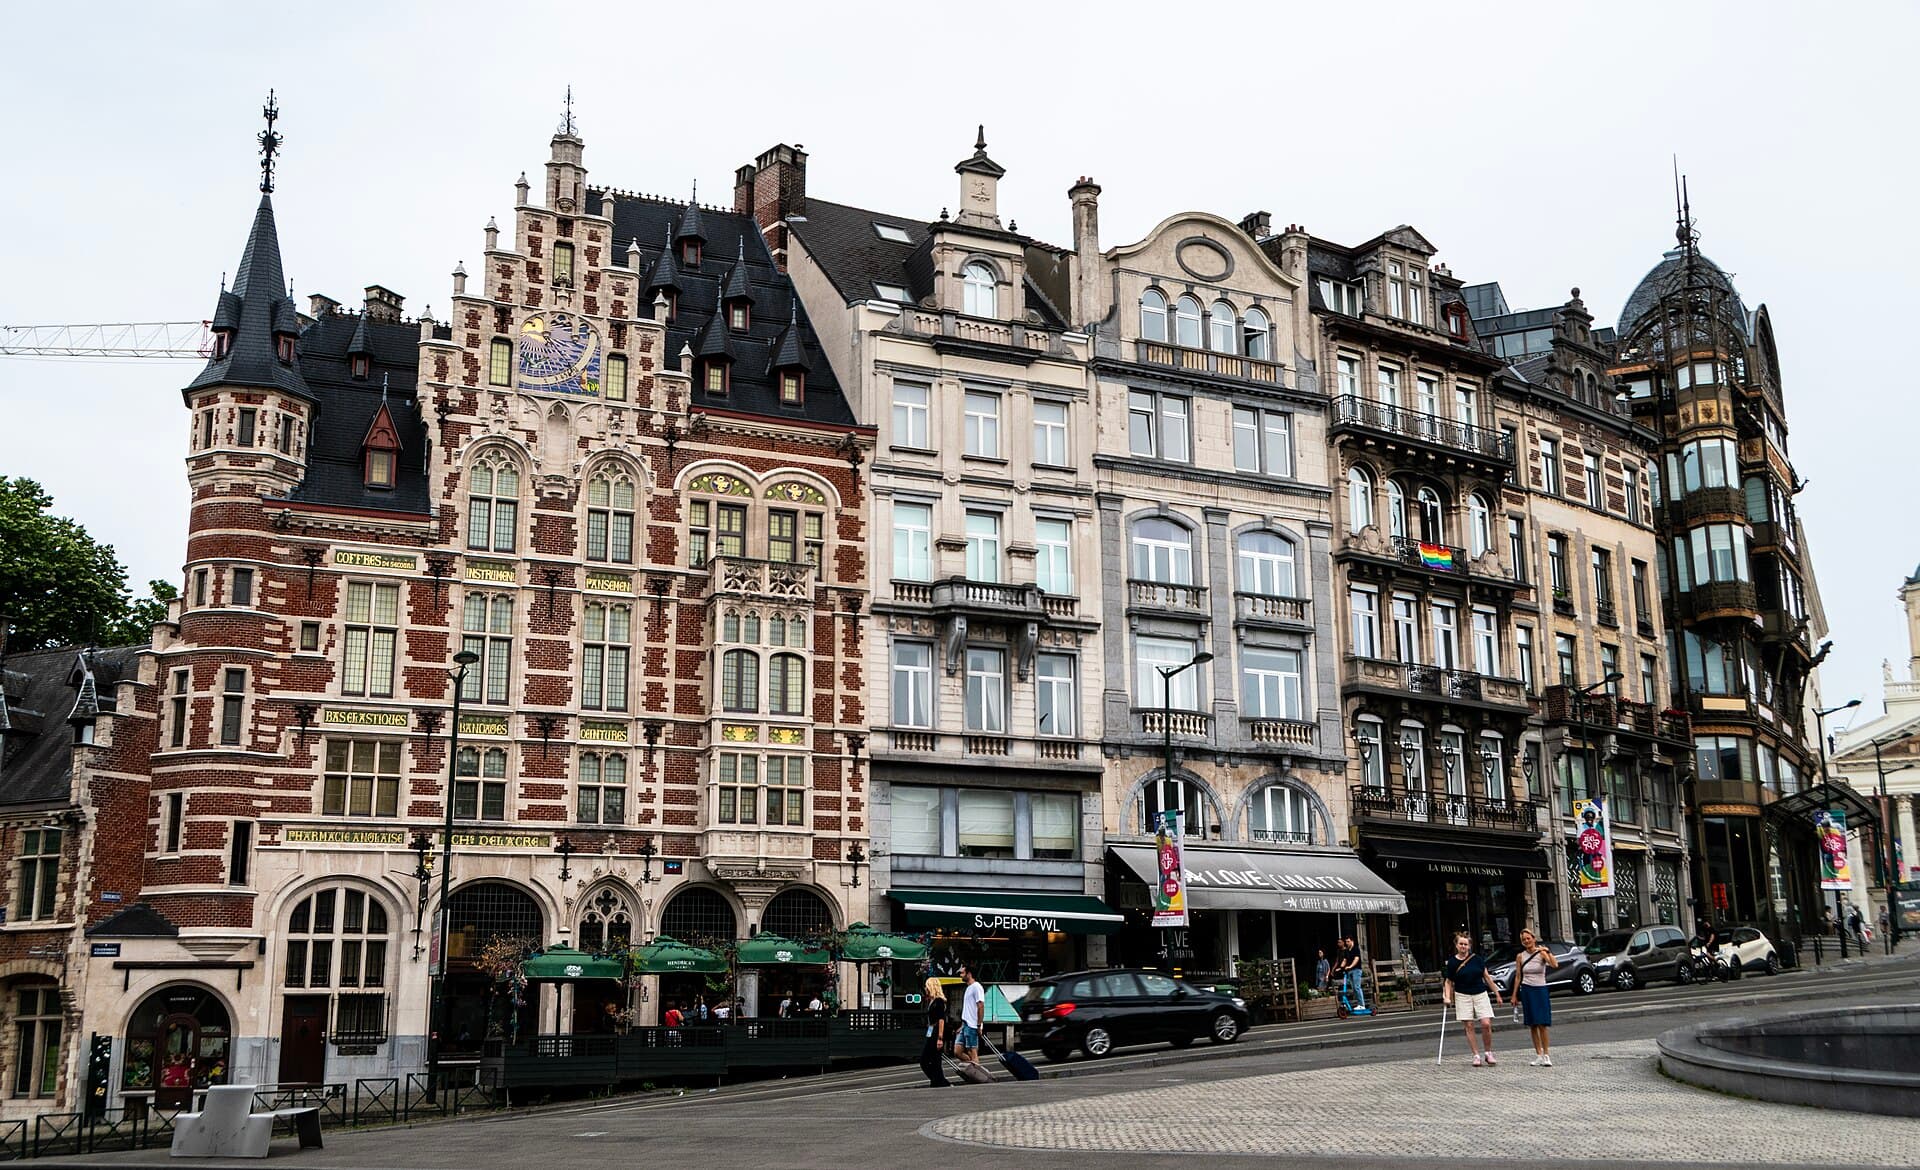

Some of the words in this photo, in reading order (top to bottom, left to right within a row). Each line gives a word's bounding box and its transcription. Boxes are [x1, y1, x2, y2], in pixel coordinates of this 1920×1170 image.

[336, 551, 382, 567] COFFRES
[459, 722, 508, 735] BANDAGES
[287, 830, 350, 842] PHARMACIE
[352, 832, 403, 844] ANGLAISE
[1385, 860, 1398, 869] CD
[1428, 863, 1439, 872] LA
[1205, 868, 1271, 886] LOVE
[974, 914, 1061, 932] SUPERBOWL
[1161, 930, 1190, 948] LVE
